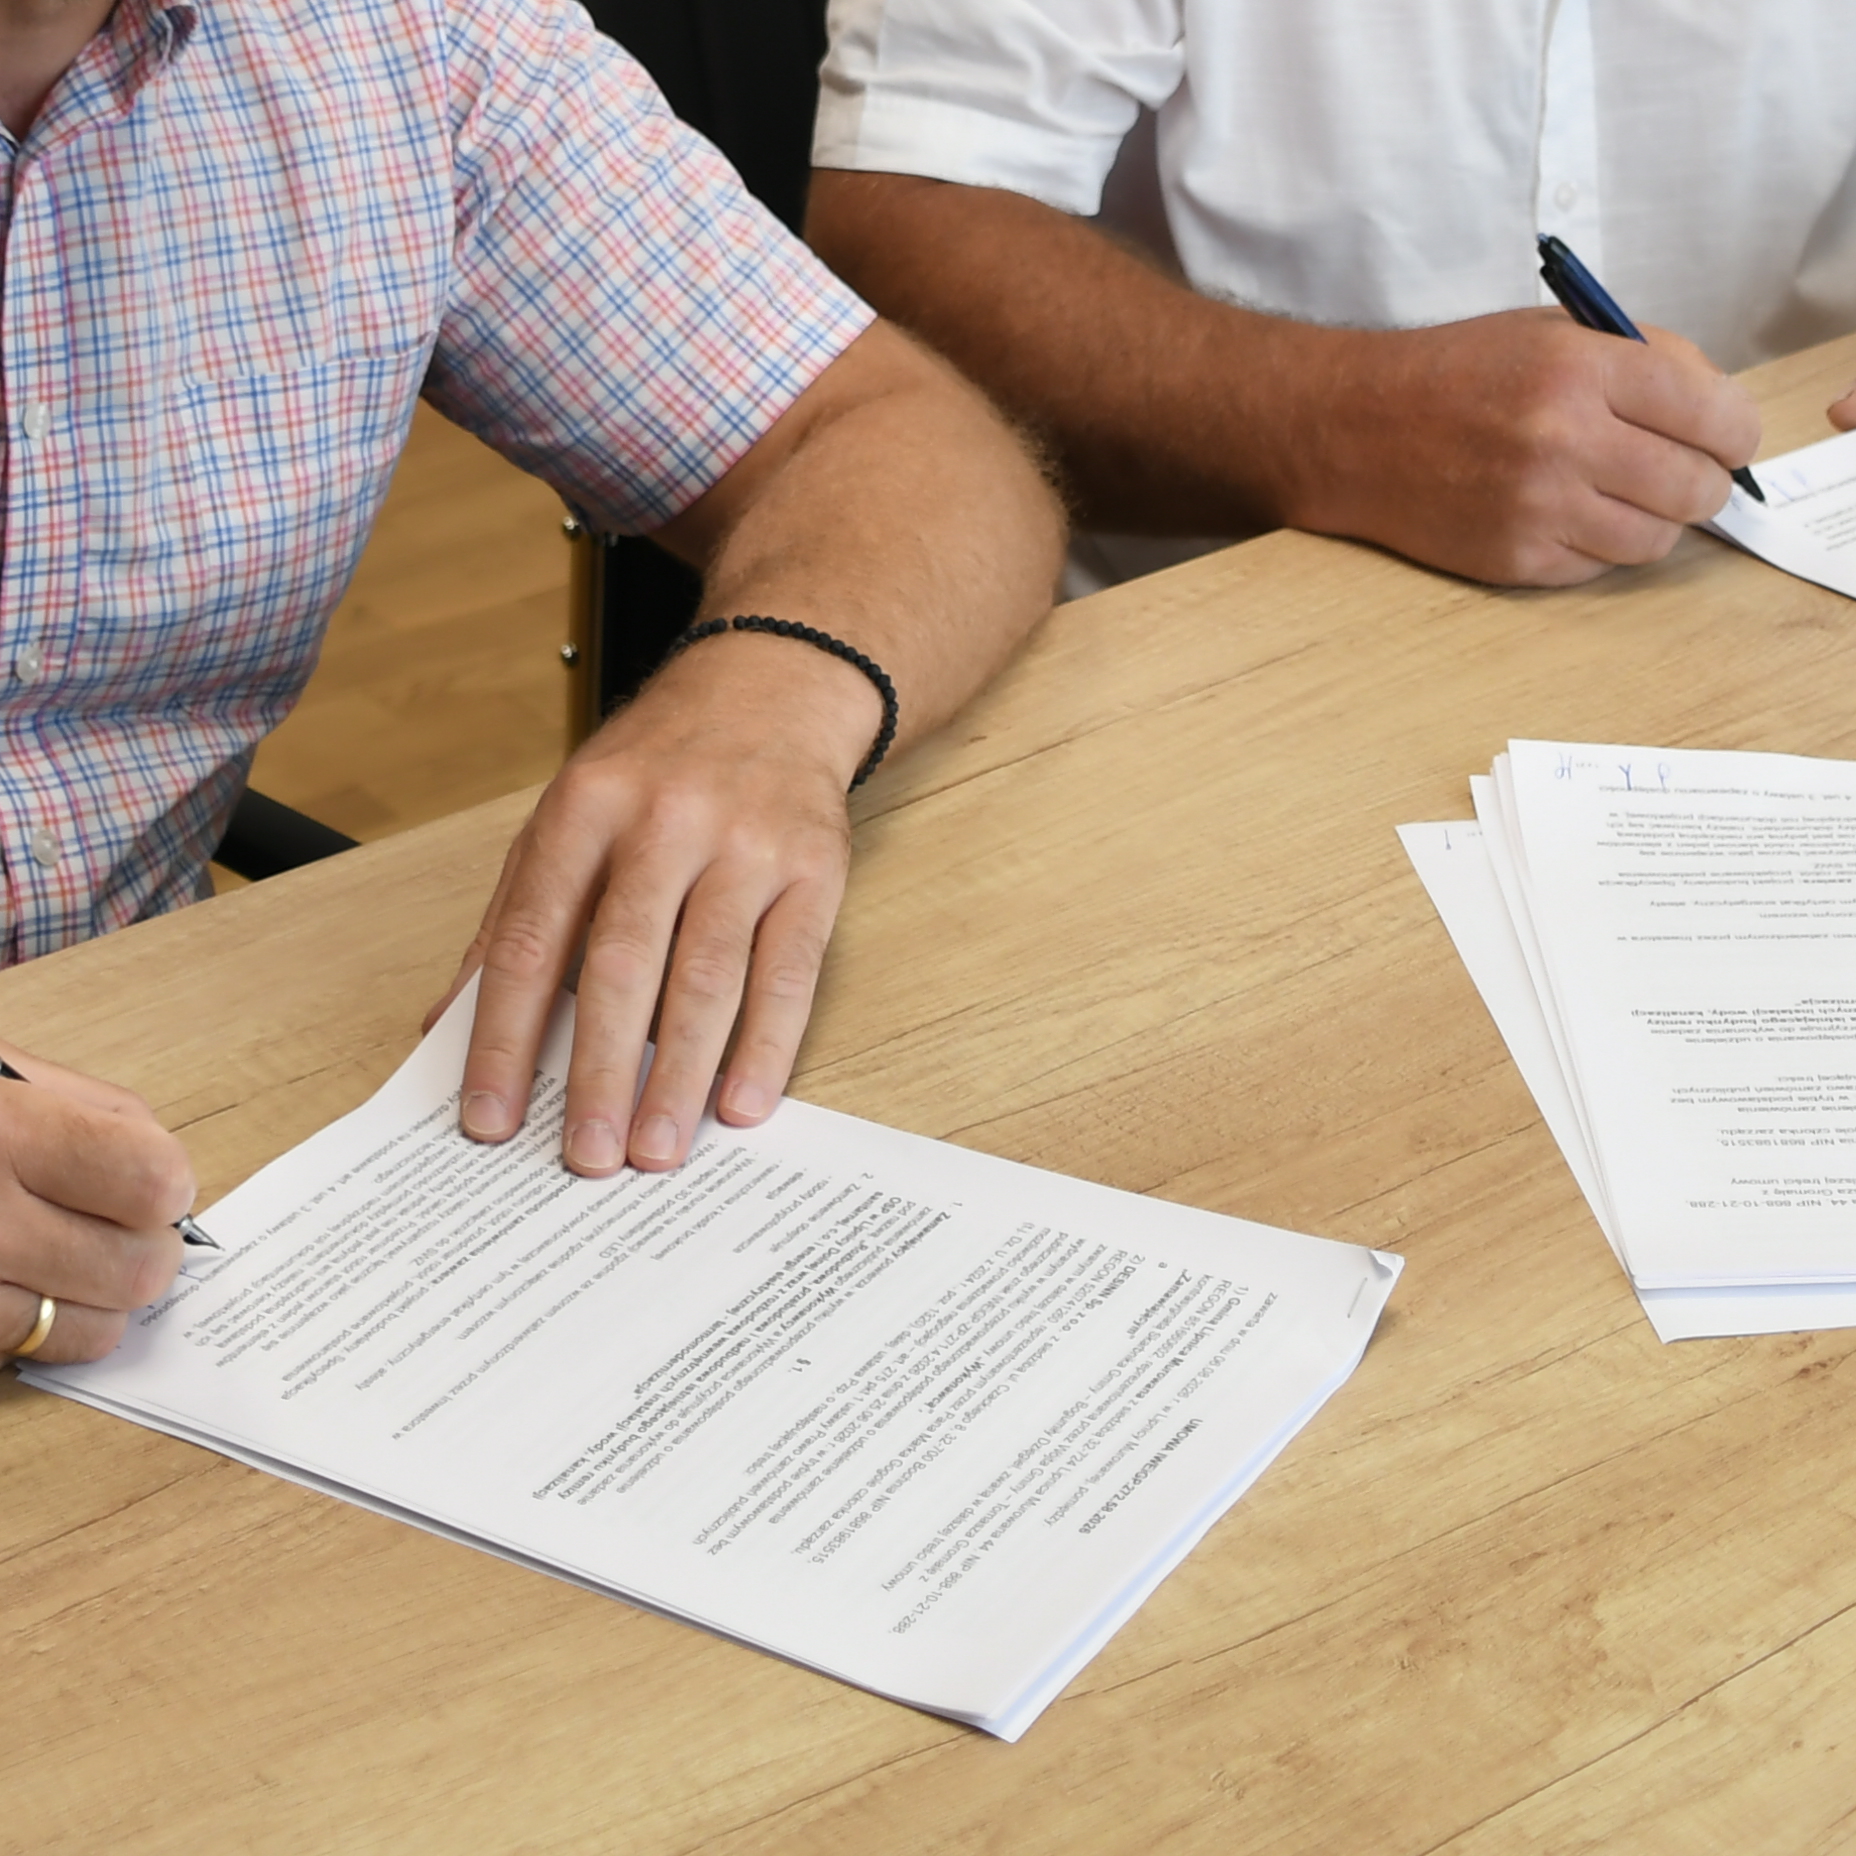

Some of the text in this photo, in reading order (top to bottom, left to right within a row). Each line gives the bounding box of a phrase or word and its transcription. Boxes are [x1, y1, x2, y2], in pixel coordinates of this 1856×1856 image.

[1070, 1243, 1108, 1277] zwanym
[1089, 1249, 1129, 1283] REGON
[1032, 1284, 1068, 1310] dalszej
[1097, 1265, 1137, 1299] DESINN
[1194, 1279, 1233, 1316] REGON
[1151, 1273, 1215, 1331] kontrasygnatą
[1205, 1296, 1242, 1326] Gminą
[1244, 1292, 1279, 1328] zawarta
[1013, 1309, 1042, 1331] treści
[972, 1324, 1049, 1390] reprezentowanym
[982, 1329, 1017, 1357] umowy
[1012, 1341, 1054, 1373] siedzibą
[1116, 1330, 1162, 1369] Skarbnika
[1176, 1325, 1215, 1357] Lipnica
[1219, 1337, 1242, 1355] dniu
[1083, 1359, 1155, 1421] reprezentowaną
[1087, 1368, 1123, 1395] Gminy
[1135, 1356, 1184, 1399] Murowana
[948, 1387, 977, 1411] przez
[960, 1384, 1011, 1424] Czackiego
[925, 1411, 956, 1433] Pana
[1042, 1400, 1089, 1438] Bogumiły
[1062, 1419, 1091, 1444] przez
[1091, 1405, 1133, 1438] siedzibą
[1130, 1412, 1168, 1441] Lipnicy
[1161, 1418, 1203, 1452] UMOWA
[897, 1432, 933, 1458] Marka
[1038, 1443, 1071, 1467] Wójta
[884, 1461, 927, 1495] Bochnia
[976, 1470, 1013, 1498] zwaną
[1008, 1467, 1045, 1495] Gminy
[1033, 1466, 1072, 1496] Lipnica
[831, 1488, 870, 1520] członka
[989, 1495, 1042, 1539] Murowana
[936, 1506, 976, 1537] dalszej
[964, 1502, 1011, 1539] Tomasza
[914, 1537, 946, 1561] treści
[923, 1538, 970, 1575] Gromalę
[880, 1560, 919, 1592] umowy
